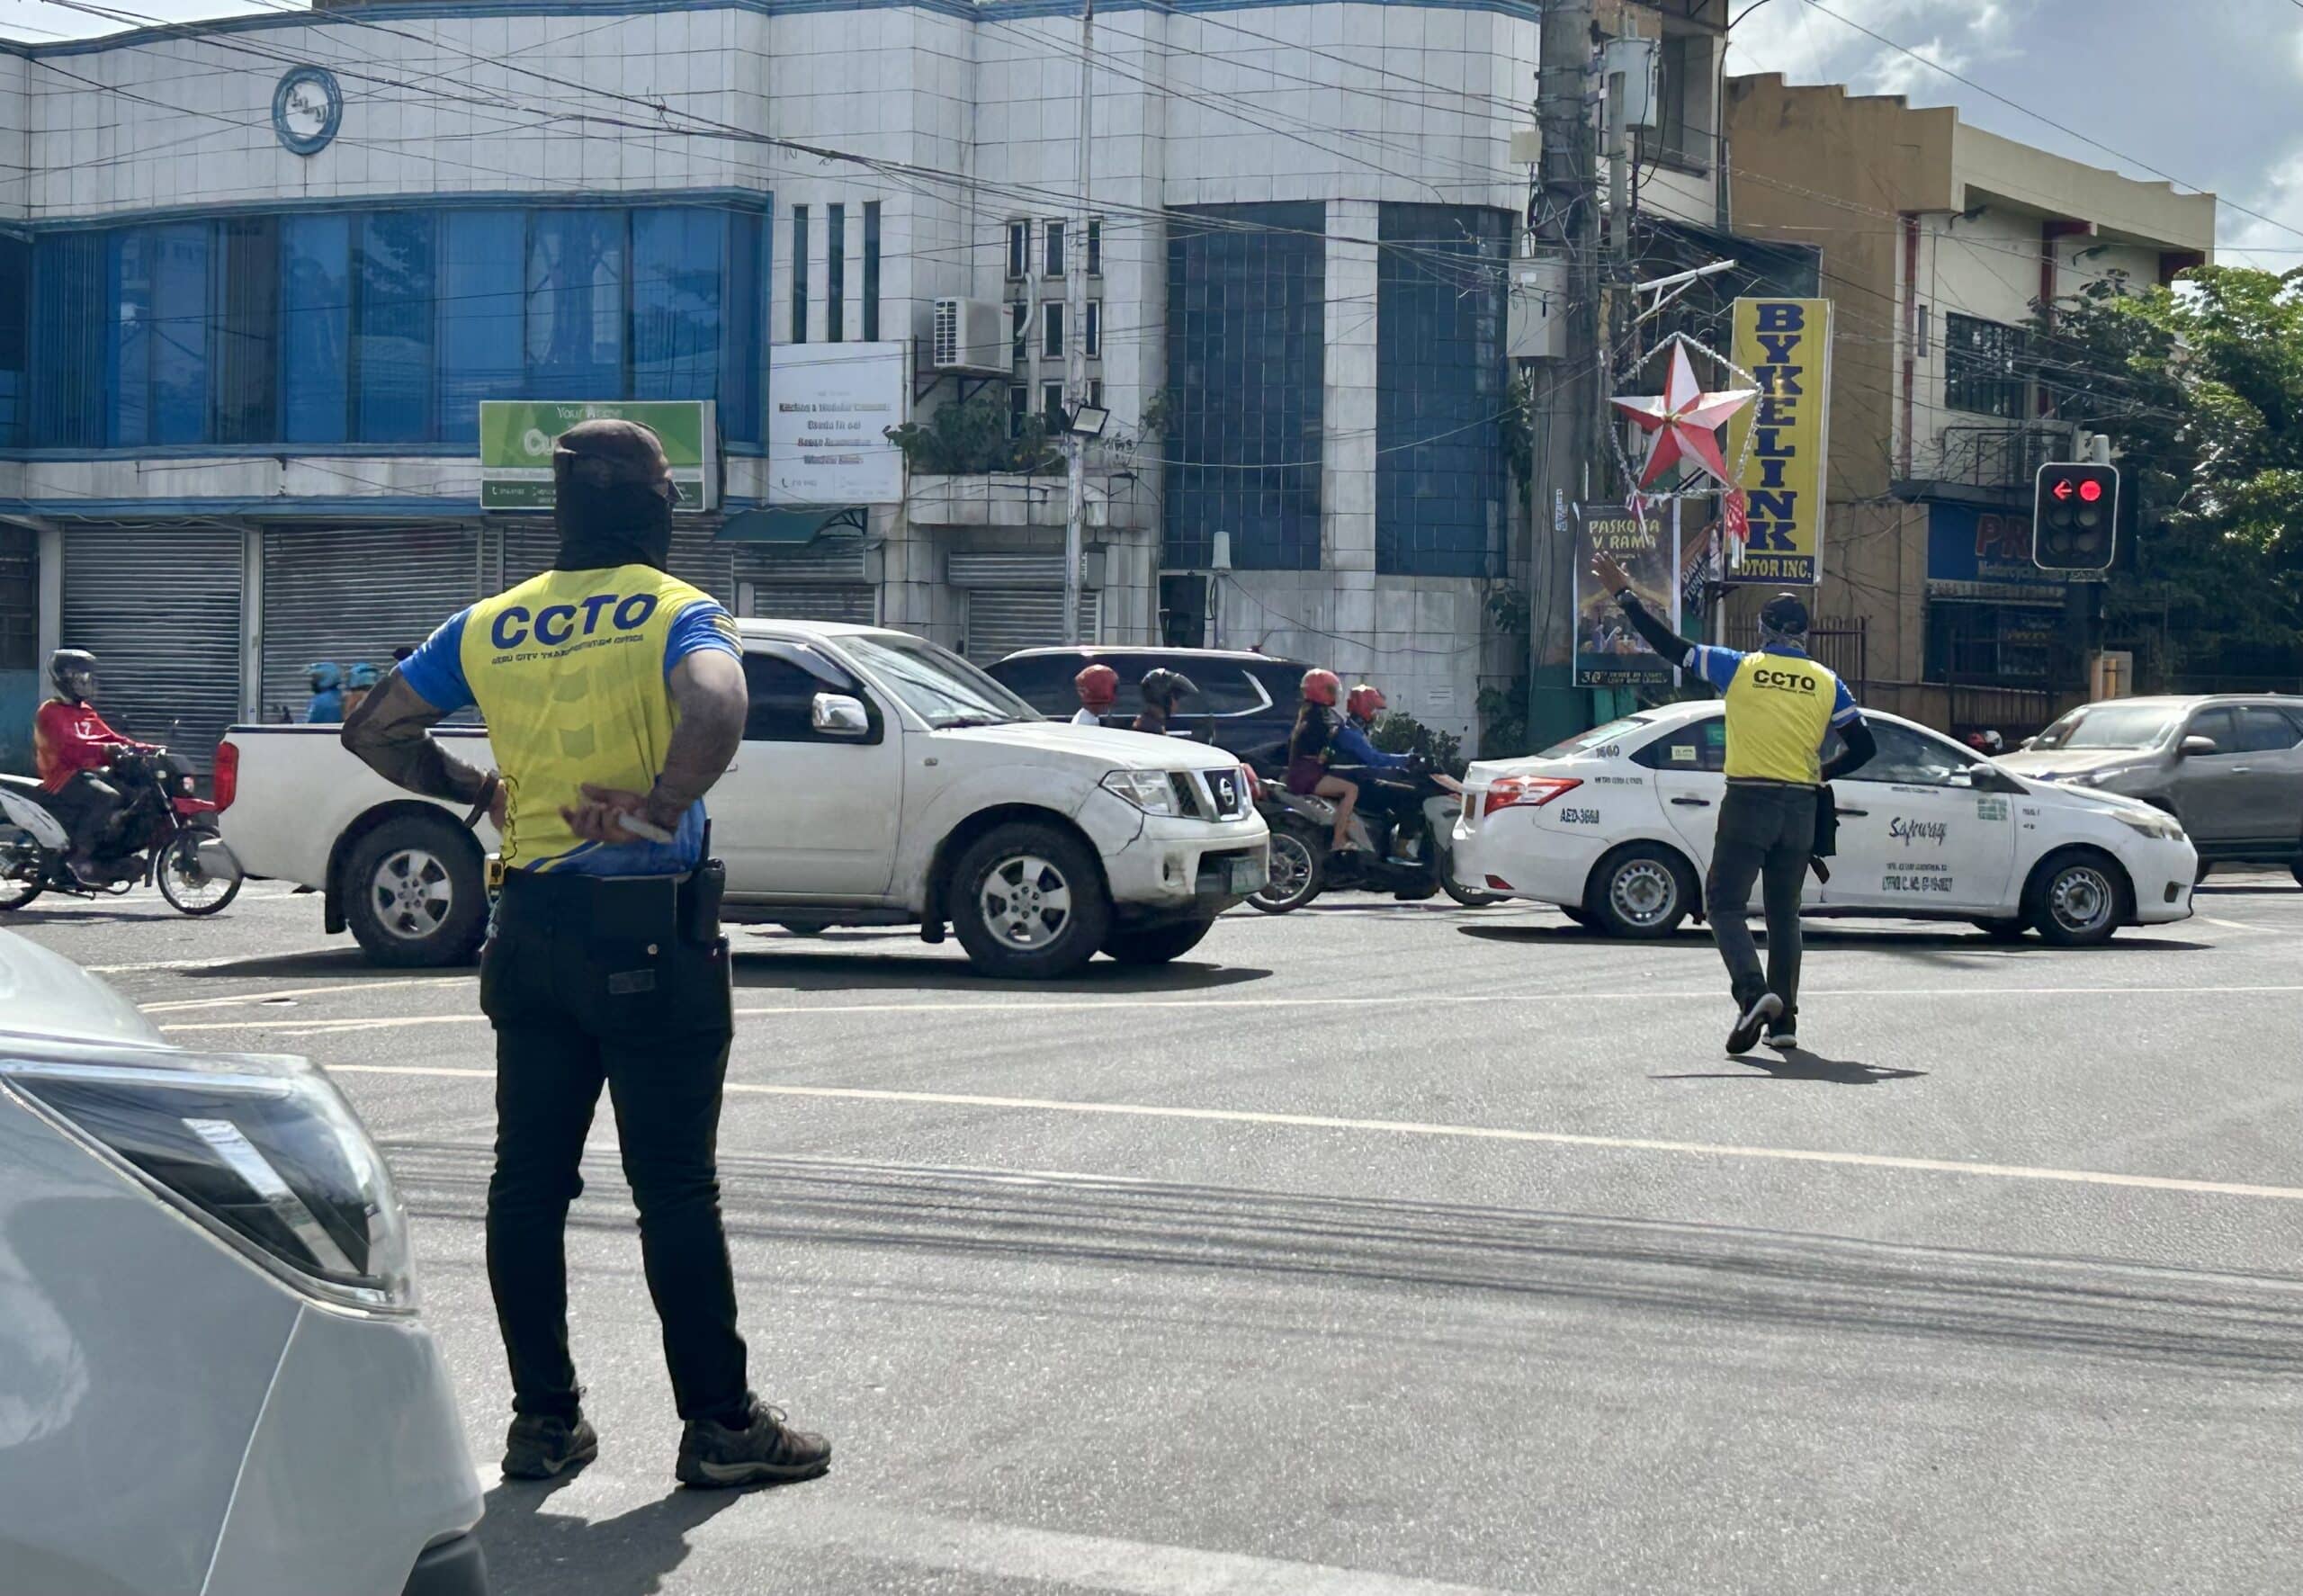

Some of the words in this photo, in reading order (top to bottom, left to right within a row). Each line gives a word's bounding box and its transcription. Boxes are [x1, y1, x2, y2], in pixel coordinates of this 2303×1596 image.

[1745, 303, 1805, 551] BYKELINK
[1589, 519, 1636, 533] PASKO
[1610, 535, 1657, 549] RAMA
[1729, 559, 1779, 578] OTOR
[1782, 559, 1812, 578] INC.
[491, 593, 658, 649] CCTO
[1753, 669, 1815, 690] CCTO
